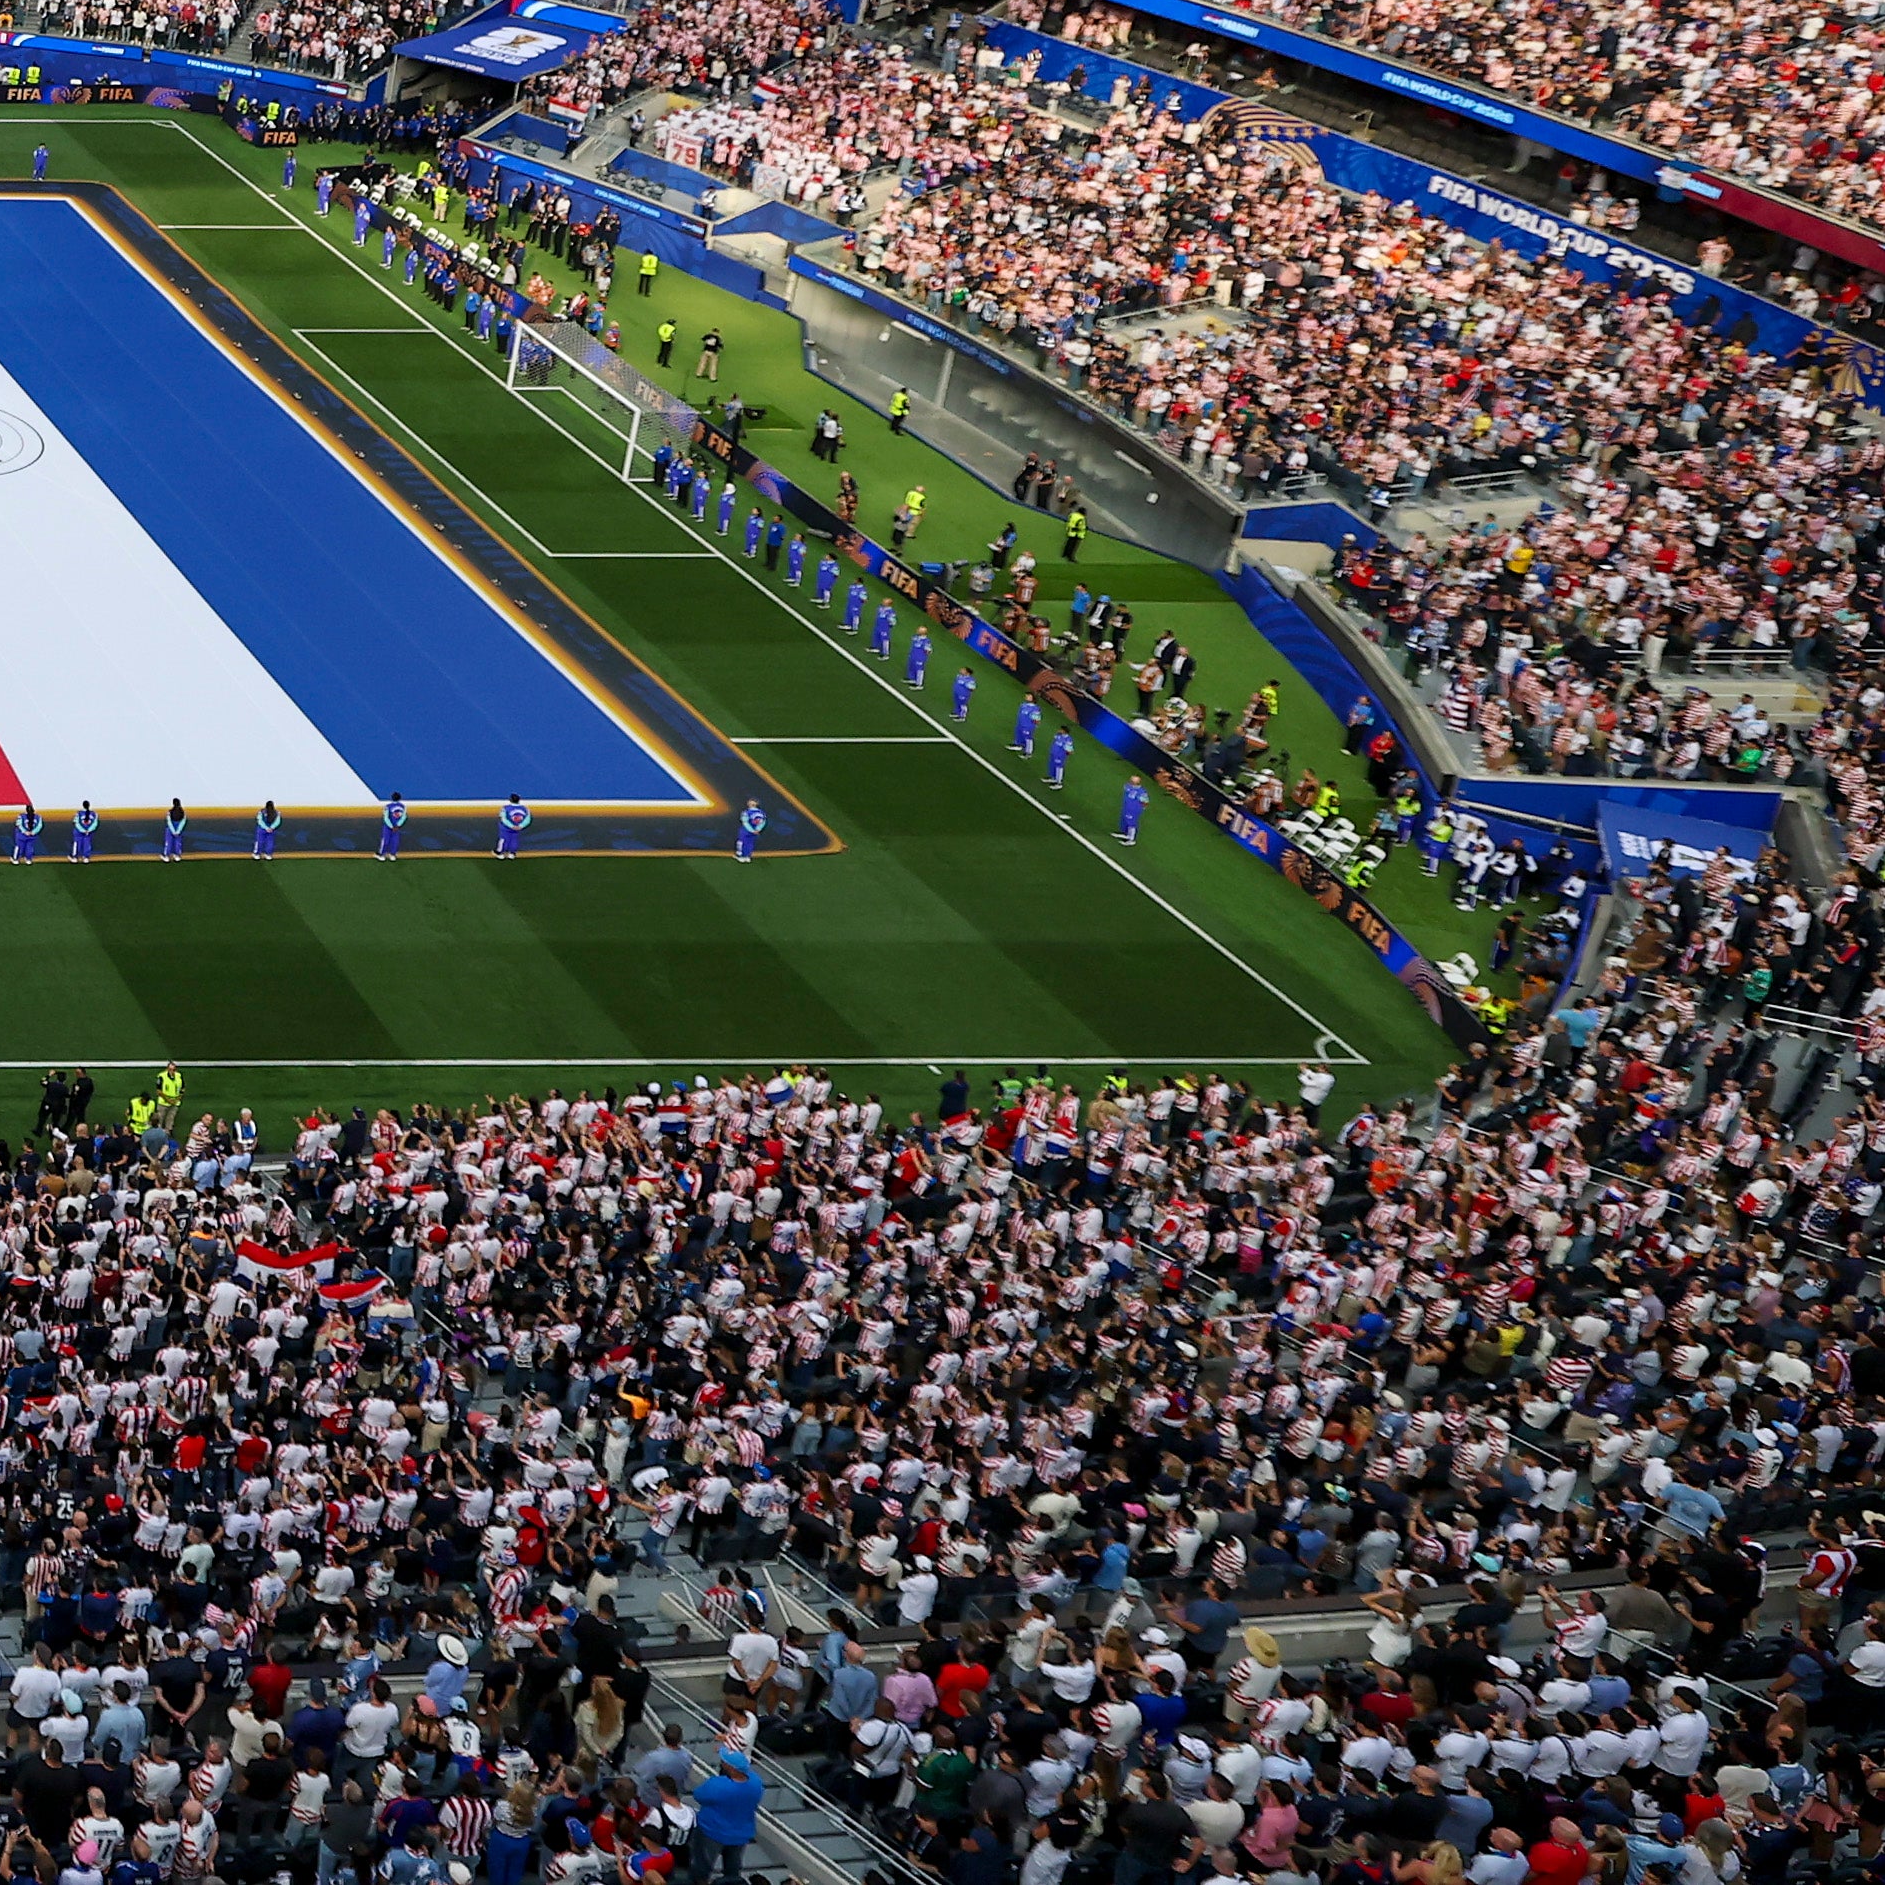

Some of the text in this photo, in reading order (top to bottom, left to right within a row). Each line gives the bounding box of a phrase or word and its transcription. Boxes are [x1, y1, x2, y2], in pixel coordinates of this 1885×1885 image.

[6, 87, 42, 101] FIFA
[99, 88, 134, 100] FIFA
[263, 131, 297, 145] FIFA
[1427, 174, 1478, 211] FIFA
[1478, 192, 1560, 242] WORLD
[880, 560, 919, 600] FIFA
[977, 630, 1018, 672] FIFA
[1216, 804, 1269, 855] FIFA
[1347, 901, 1392, 955] FIFA
[56, 1499, 74, 1520] 25
